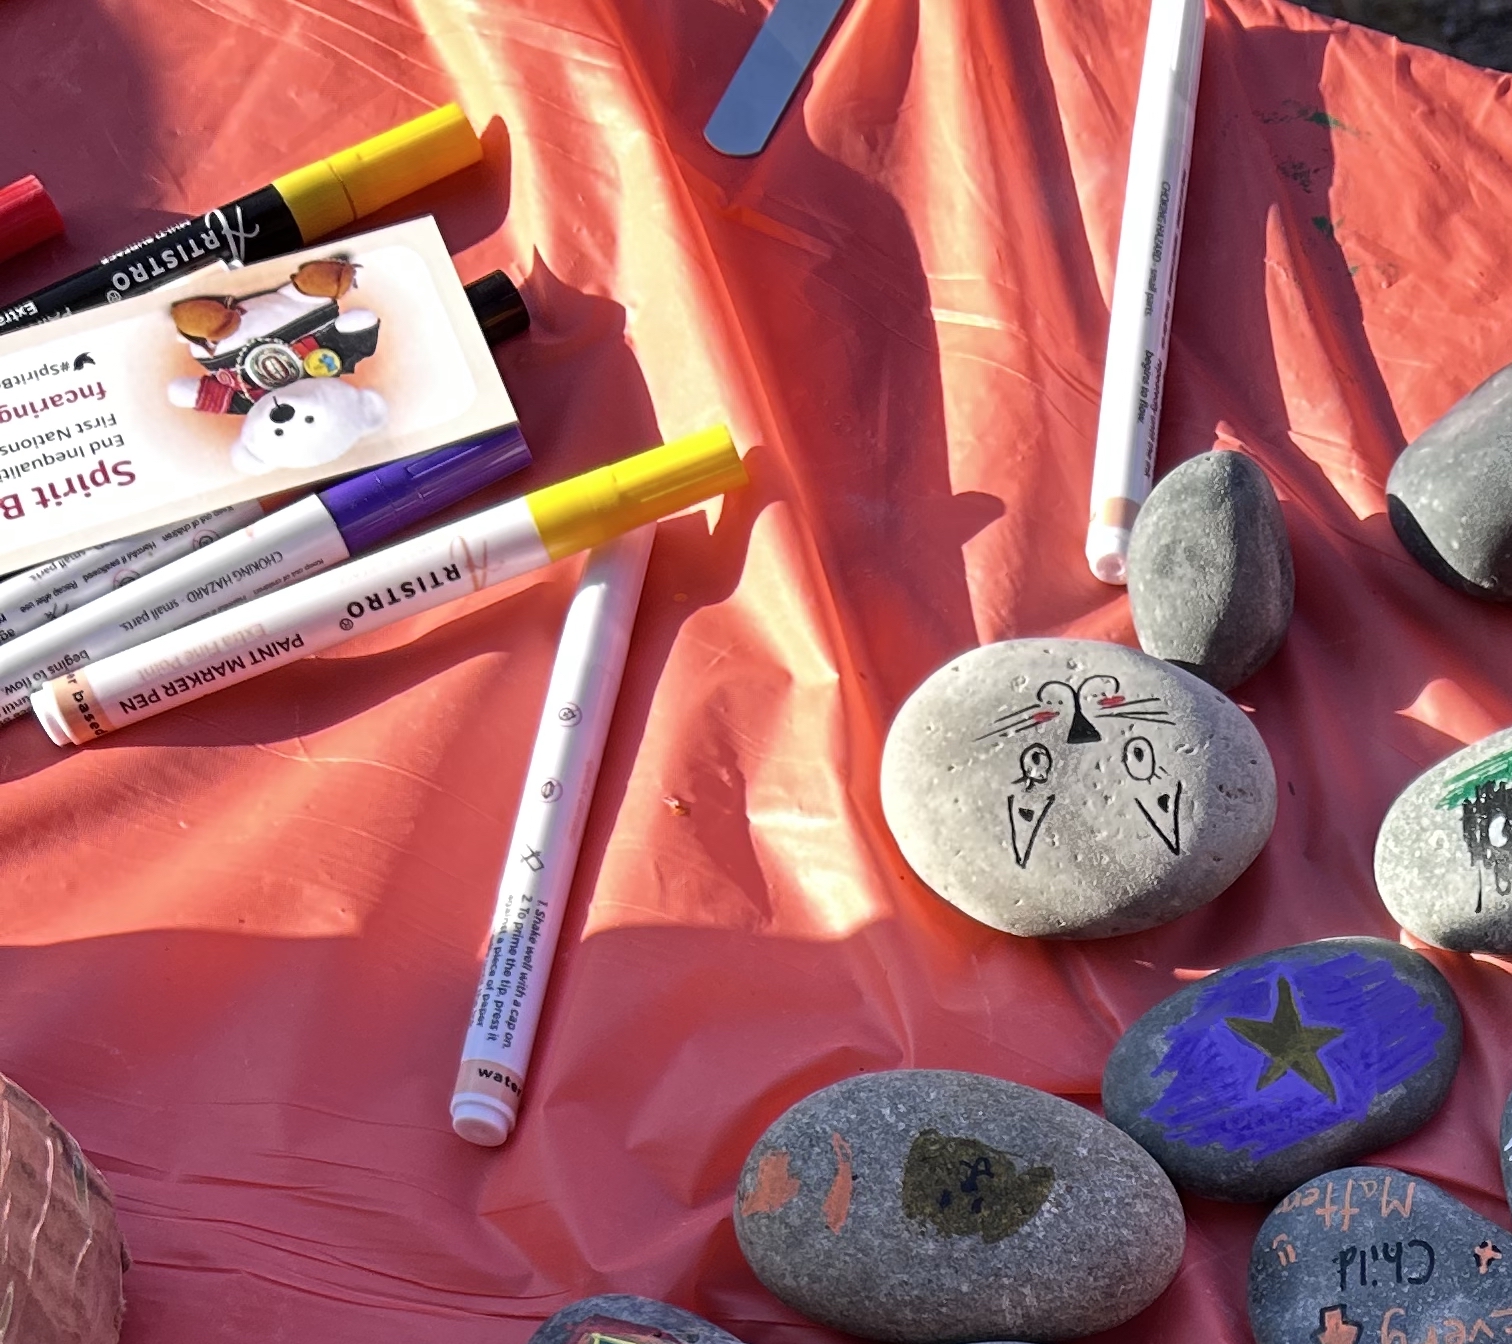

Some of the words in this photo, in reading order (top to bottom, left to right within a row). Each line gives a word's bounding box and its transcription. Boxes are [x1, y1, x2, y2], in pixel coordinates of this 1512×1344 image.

[1150, 223, 1165, 262] HAZARD
[1140, 350, 1154, 385] begins
[1140, 386, 1150, 398] to
[73, 411, 117, 435] First
[0, 425, 71, 459] Nations
[85, 431, 125, 455] End
[29, 452, 137, 512] Spirit
[231, 550, 283, 581] CHOKING
[185, 573, 231, 603] HAZARD
[118, 608, 150, 632] parts.
[149, 598, 179, 619] small
[218, 618, 265, 651] Extra
[240, 629, 305, 669] PAINT
[31, 668, 47, 684] to
[45, 647, 89, 677] begins
[162, 653, 243, 700] MARKER
[118, 685, 164, 718] PEN
[516, 906, 529, 920] To
[527, 908, 545, 944] Shake
[504, 921, 524, 956] prime
[503, 957, 516, 977] the
[521, 945, 535, 970] well
[514, 972, 529, 998] with
[487, 999, 504, 1030] press
[504, 1007, 518, 1027] cap
[512, 999, 520, 1007] a
[487, 1032, 498, 1042] it
[501, 1032, 513, 1050] on.
[1332, 1239, 1434, 1290] Child
